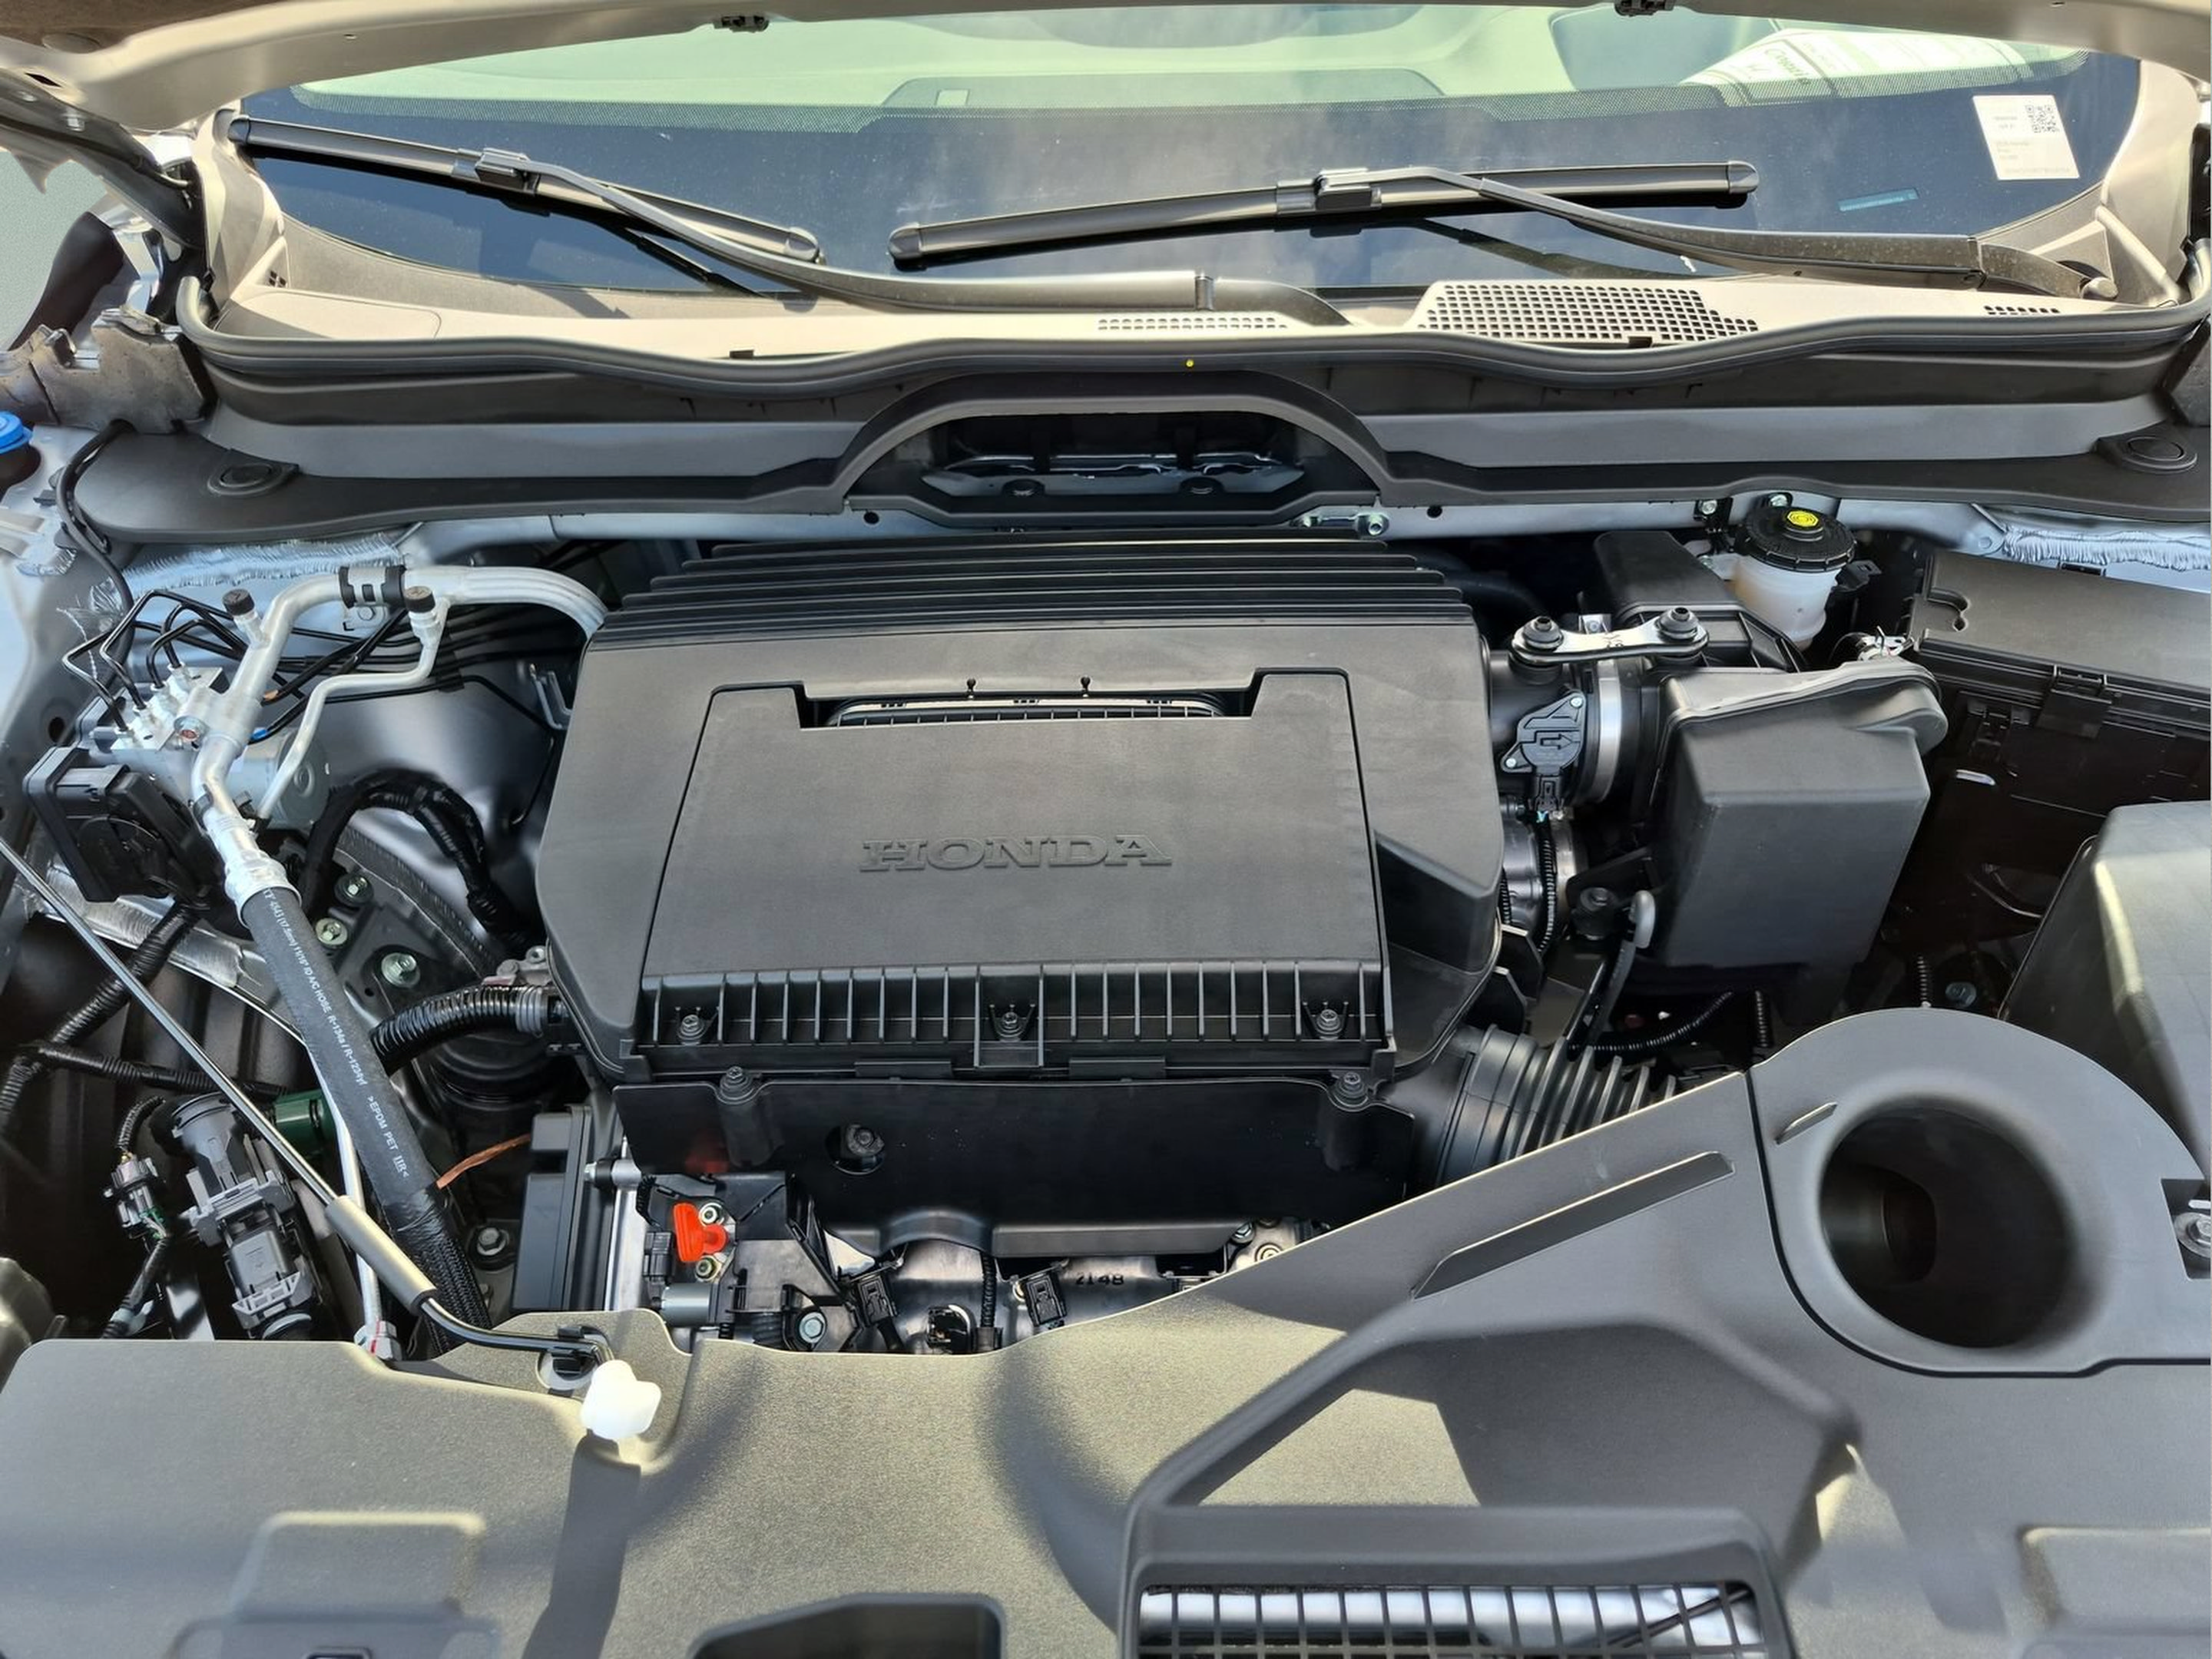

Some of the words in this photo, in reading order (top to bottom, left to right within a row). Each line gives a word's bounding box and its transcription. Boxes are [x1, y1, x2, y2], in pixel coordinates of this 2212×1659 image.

[859, 834, 1173, 873] HONDA
[314, 988, 333, 1013] HOSE
[383, 1131, 399, 1151] PET
